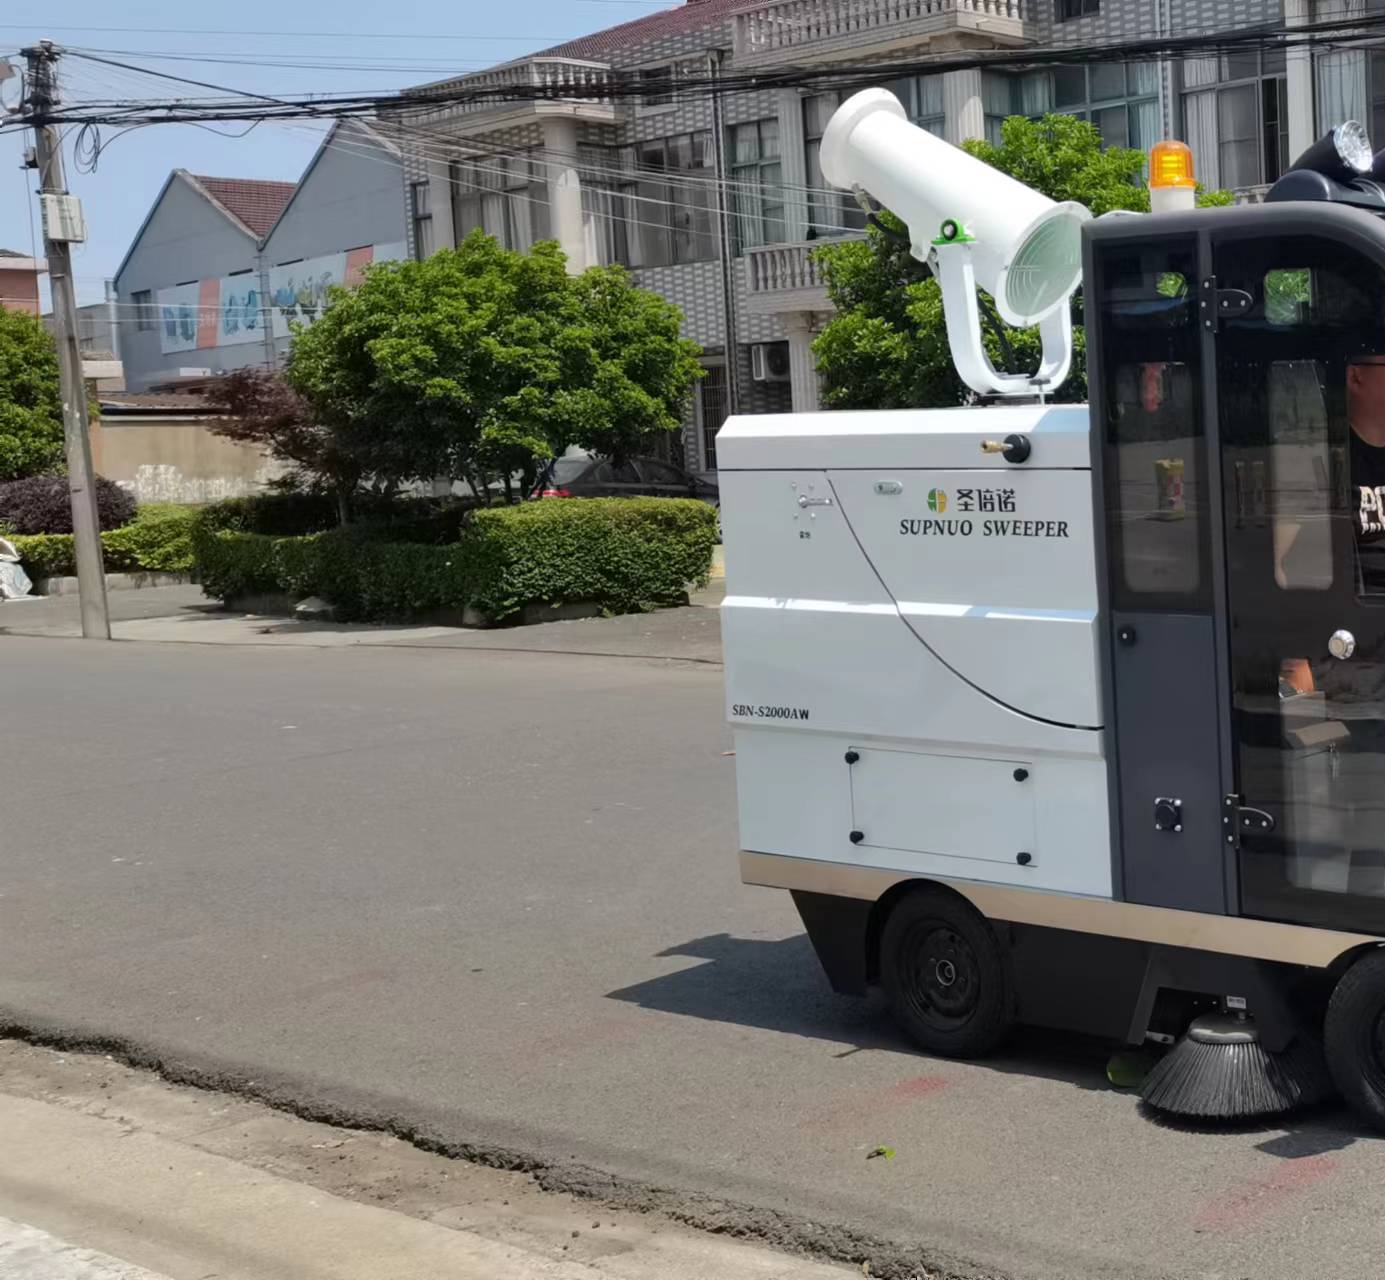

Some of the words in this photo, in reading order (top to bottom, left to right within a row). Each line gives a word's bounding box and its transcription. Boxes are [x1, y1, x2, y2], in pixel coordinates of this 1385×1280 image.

[956, 488, 1016, 513] 圣倍诺
[899, 519, 973, 537] SUPNUO
[983, 519, 1070, 538] SWEEPER
[732, 703, 809, 720] SBN-S2000AW
